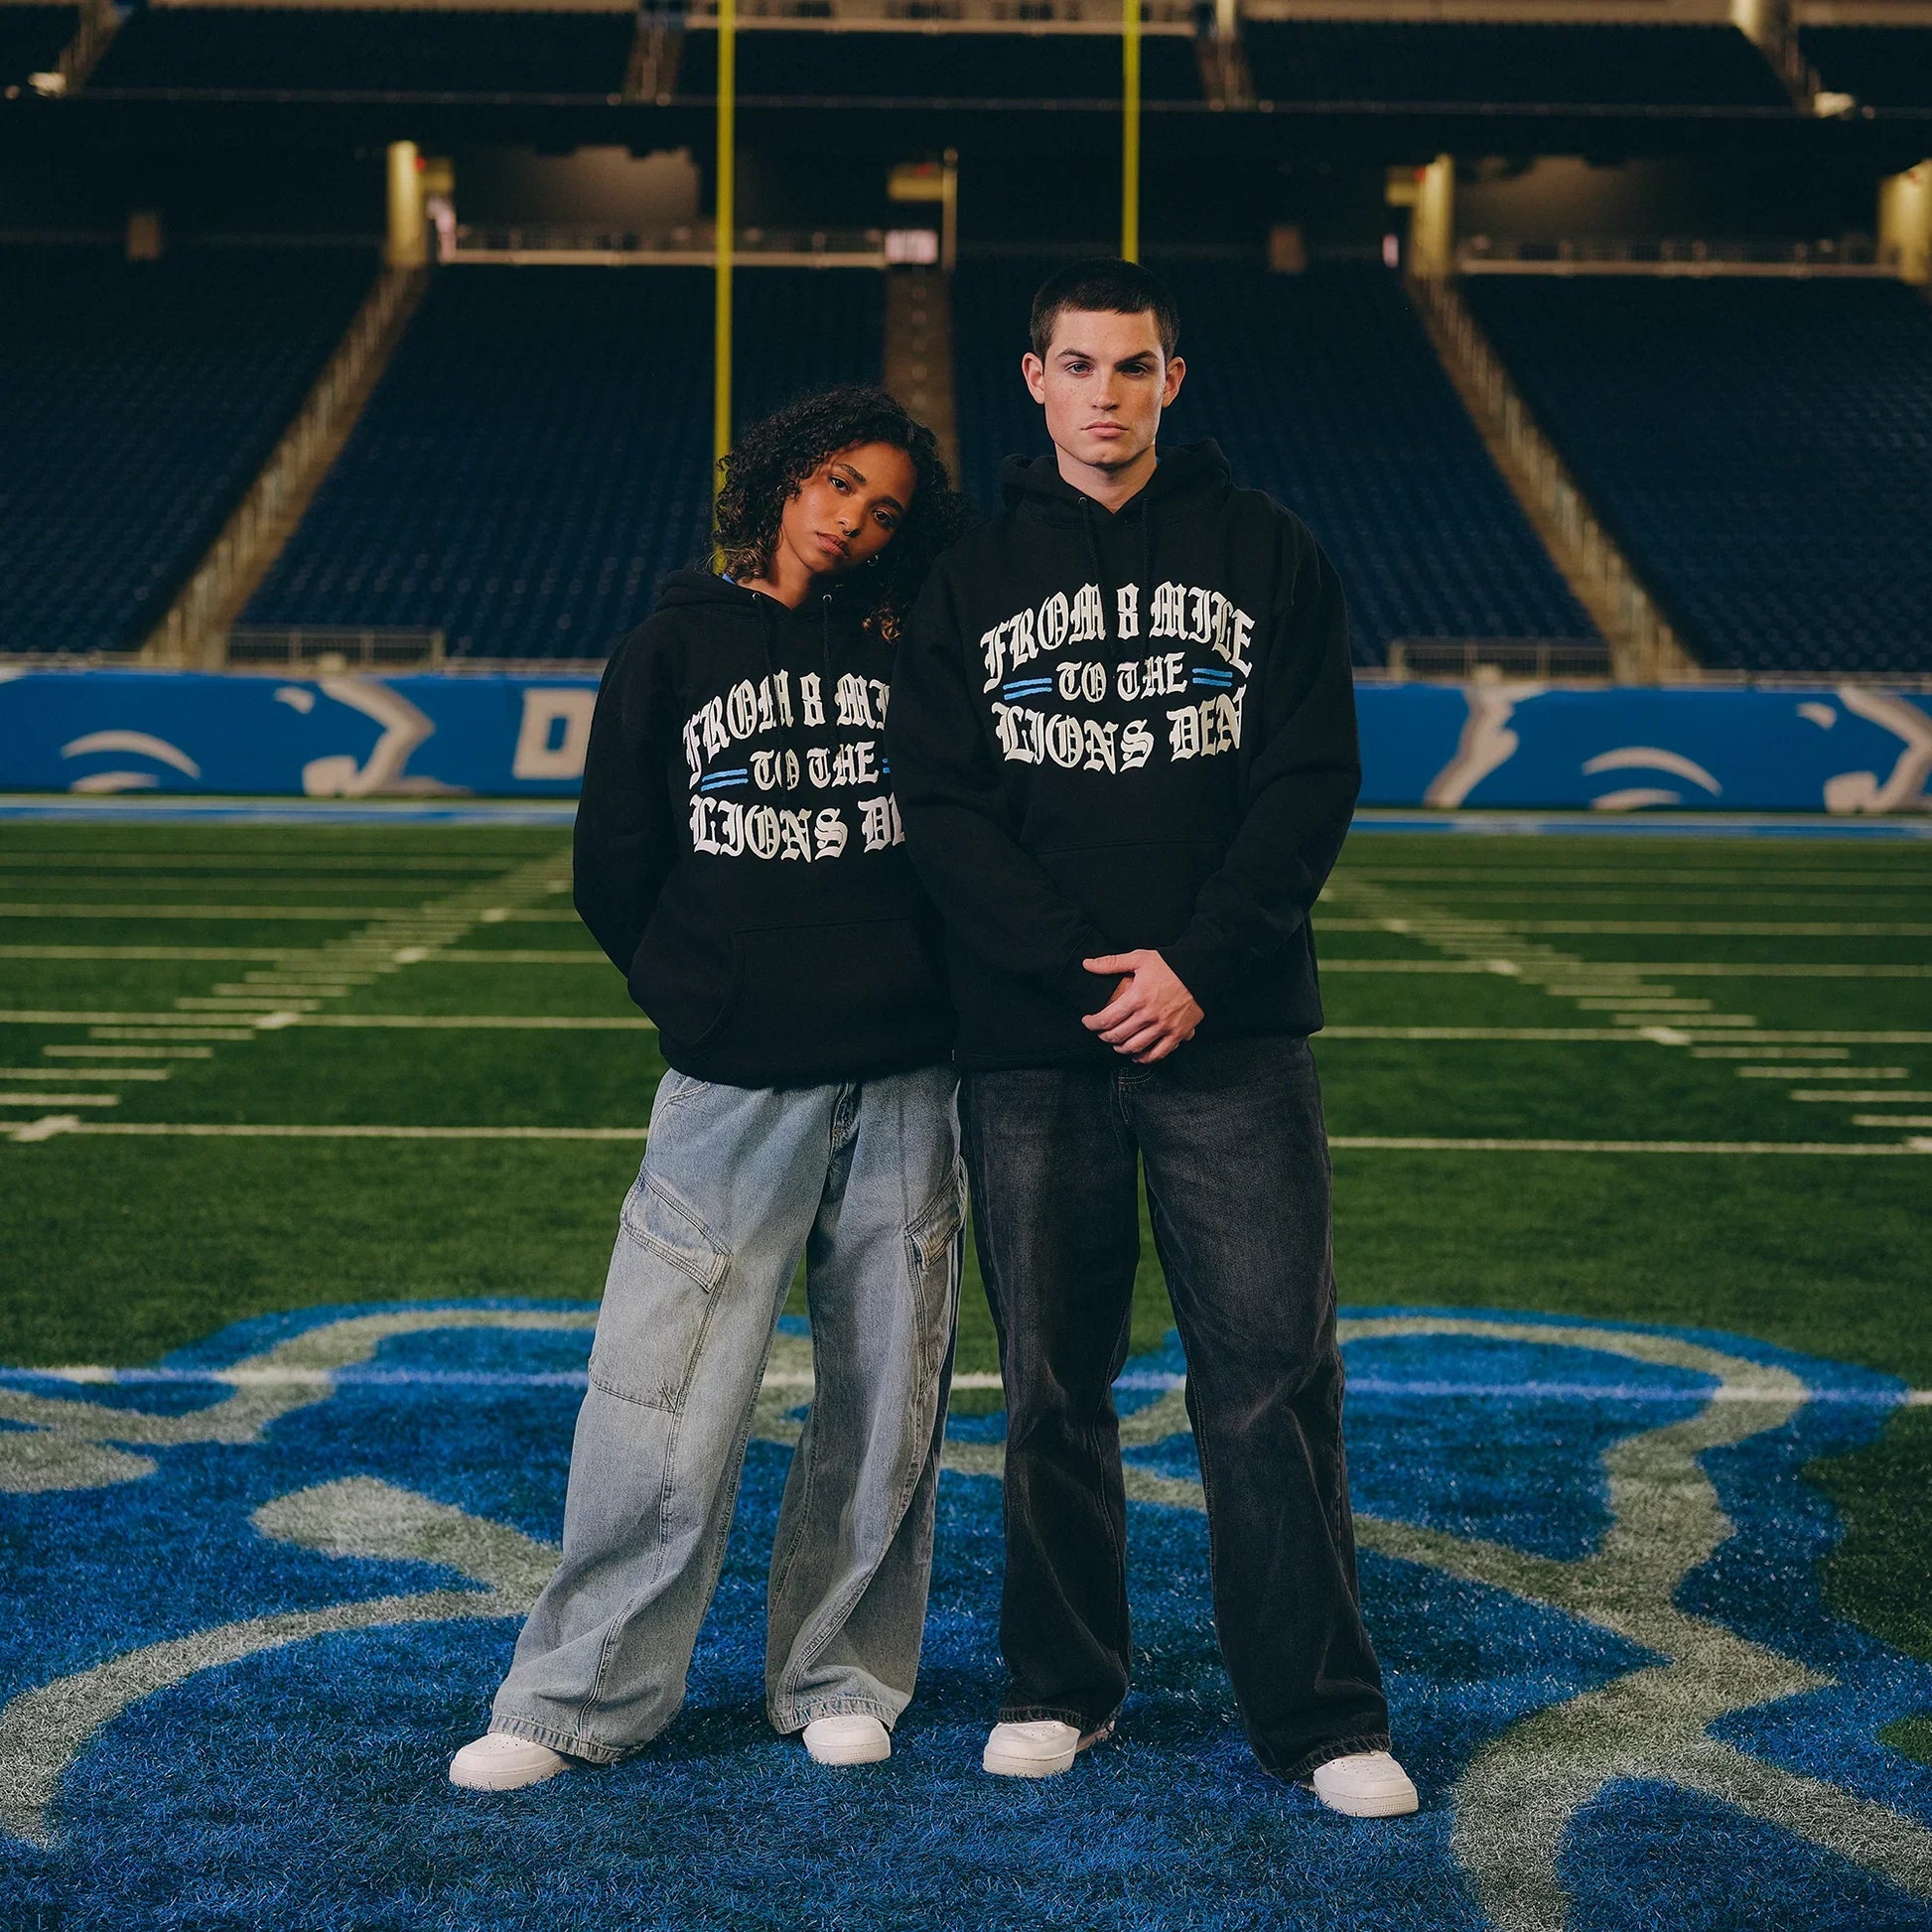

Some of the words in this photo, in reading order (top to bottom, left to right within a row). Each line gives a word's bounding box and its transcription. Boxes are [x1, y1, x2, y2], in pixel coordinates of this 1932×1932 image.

[980, 582, 1107, 693] FROM
[1117, 582, 1140, 639] 8
[1149, 581, 1256, 678] MILE
[1055, 660, 1107, 703] TO
[1116, 651, 1188, 700] THE
[683, 668, 794, 789] FROM
[799, 671, 826, 727] 8
[750, 749, 800, 791] TO
[806, 741, 880, 788] THE
[992, 701, 1155, 774] LIONS
[1166, 683, 1247, 762] DEN
[689, 793, 849, 863] LIONS
